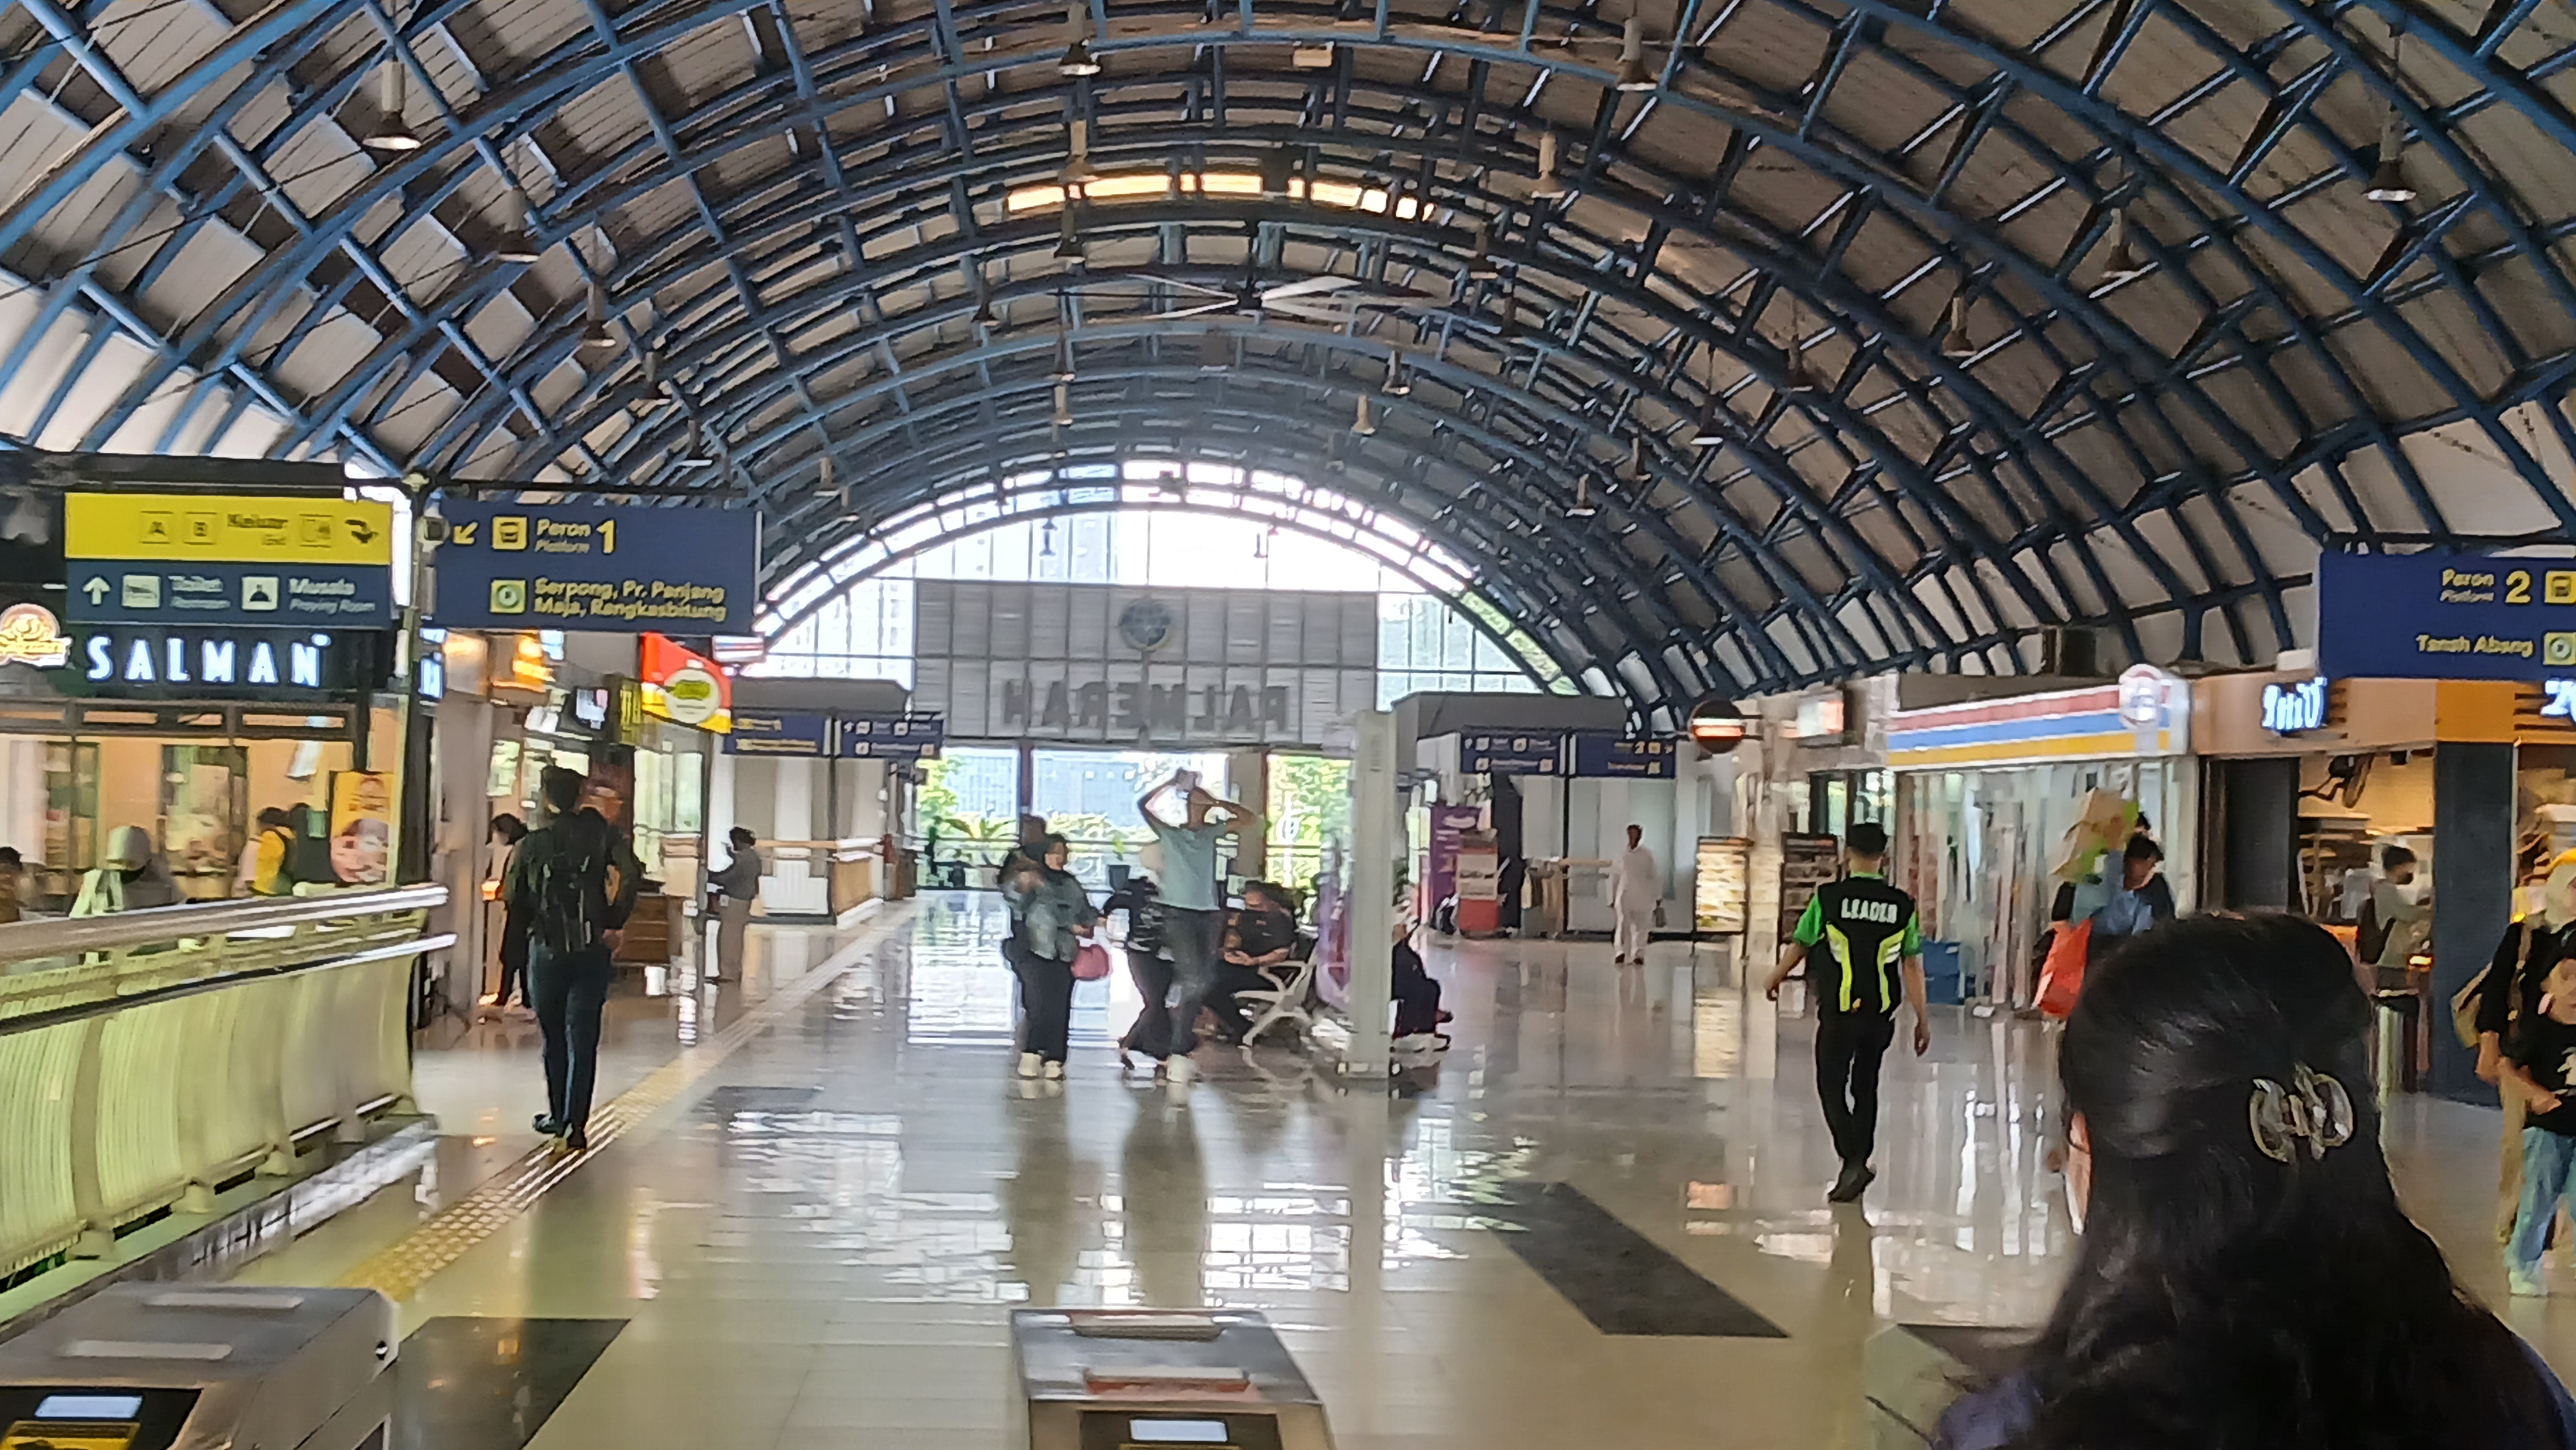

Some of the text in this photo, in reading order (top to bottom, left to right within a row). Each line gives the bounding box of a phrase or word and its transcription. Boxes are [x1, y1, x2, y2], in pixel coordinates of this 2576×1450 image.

[537, 518, 614, 554] Peron 1
[535, 577, 618, 600] Serpong,
[651, 580, 725, 604] Panjang
[2442, 568, 2531, 603] Peron 2
[534, 596, 587, 618] Maja,
[2416, 634, 2534, 658] Tanah Abang
[86, 635, 321, 688] SALMAN
[1840, 897, 1898, 924] LEADER
